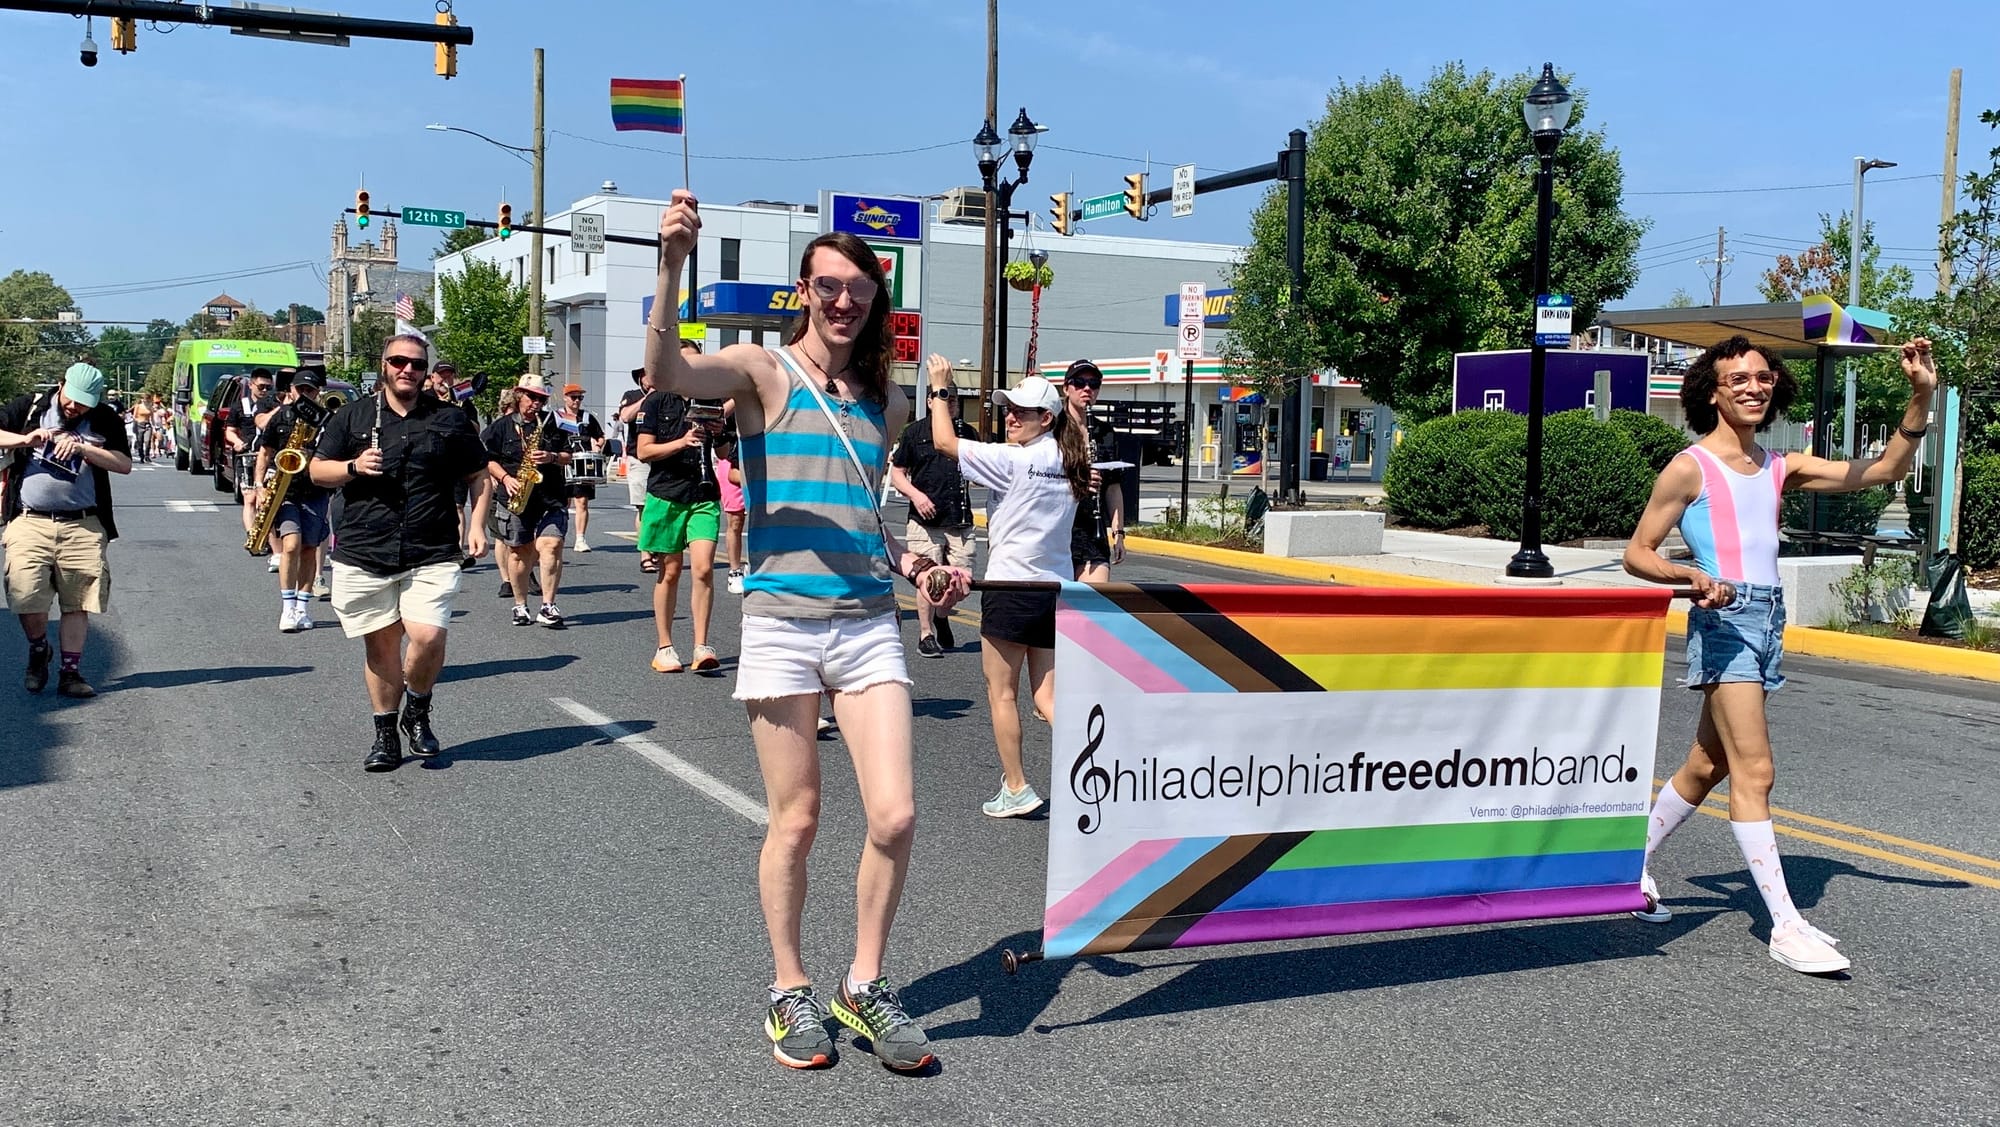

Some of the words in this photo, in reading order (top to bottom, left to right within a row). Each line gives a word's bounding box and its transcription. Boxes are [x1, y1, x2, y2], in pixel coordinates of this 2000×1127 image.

[1178, 168, 1188, 179] NO
[1176, 182, 1190, 191] TURN
[1173, 194, 1181, 203] ON
[1182, 192, 1193, 201] RED
[1085, 199, 1121, 216] Hamilton
[407, 210, 438, 223] 12th
[444, 213, 460, 225] St
[582, 216, 594, 224] NO
[856, 213, 900, 226] SUNOCO
[578, 225, 599, 233] TURN
[573, 233, 584, 241] ON
[588, 234, 602, 242] RED
[1188, 286, 1198, 294] NO
[1181, 294, 1203, 303] PARKING
[1470, 806, 1508, 818] Venmo:
[1510, 800, 1644, 819] @philadelphia-freedomband
